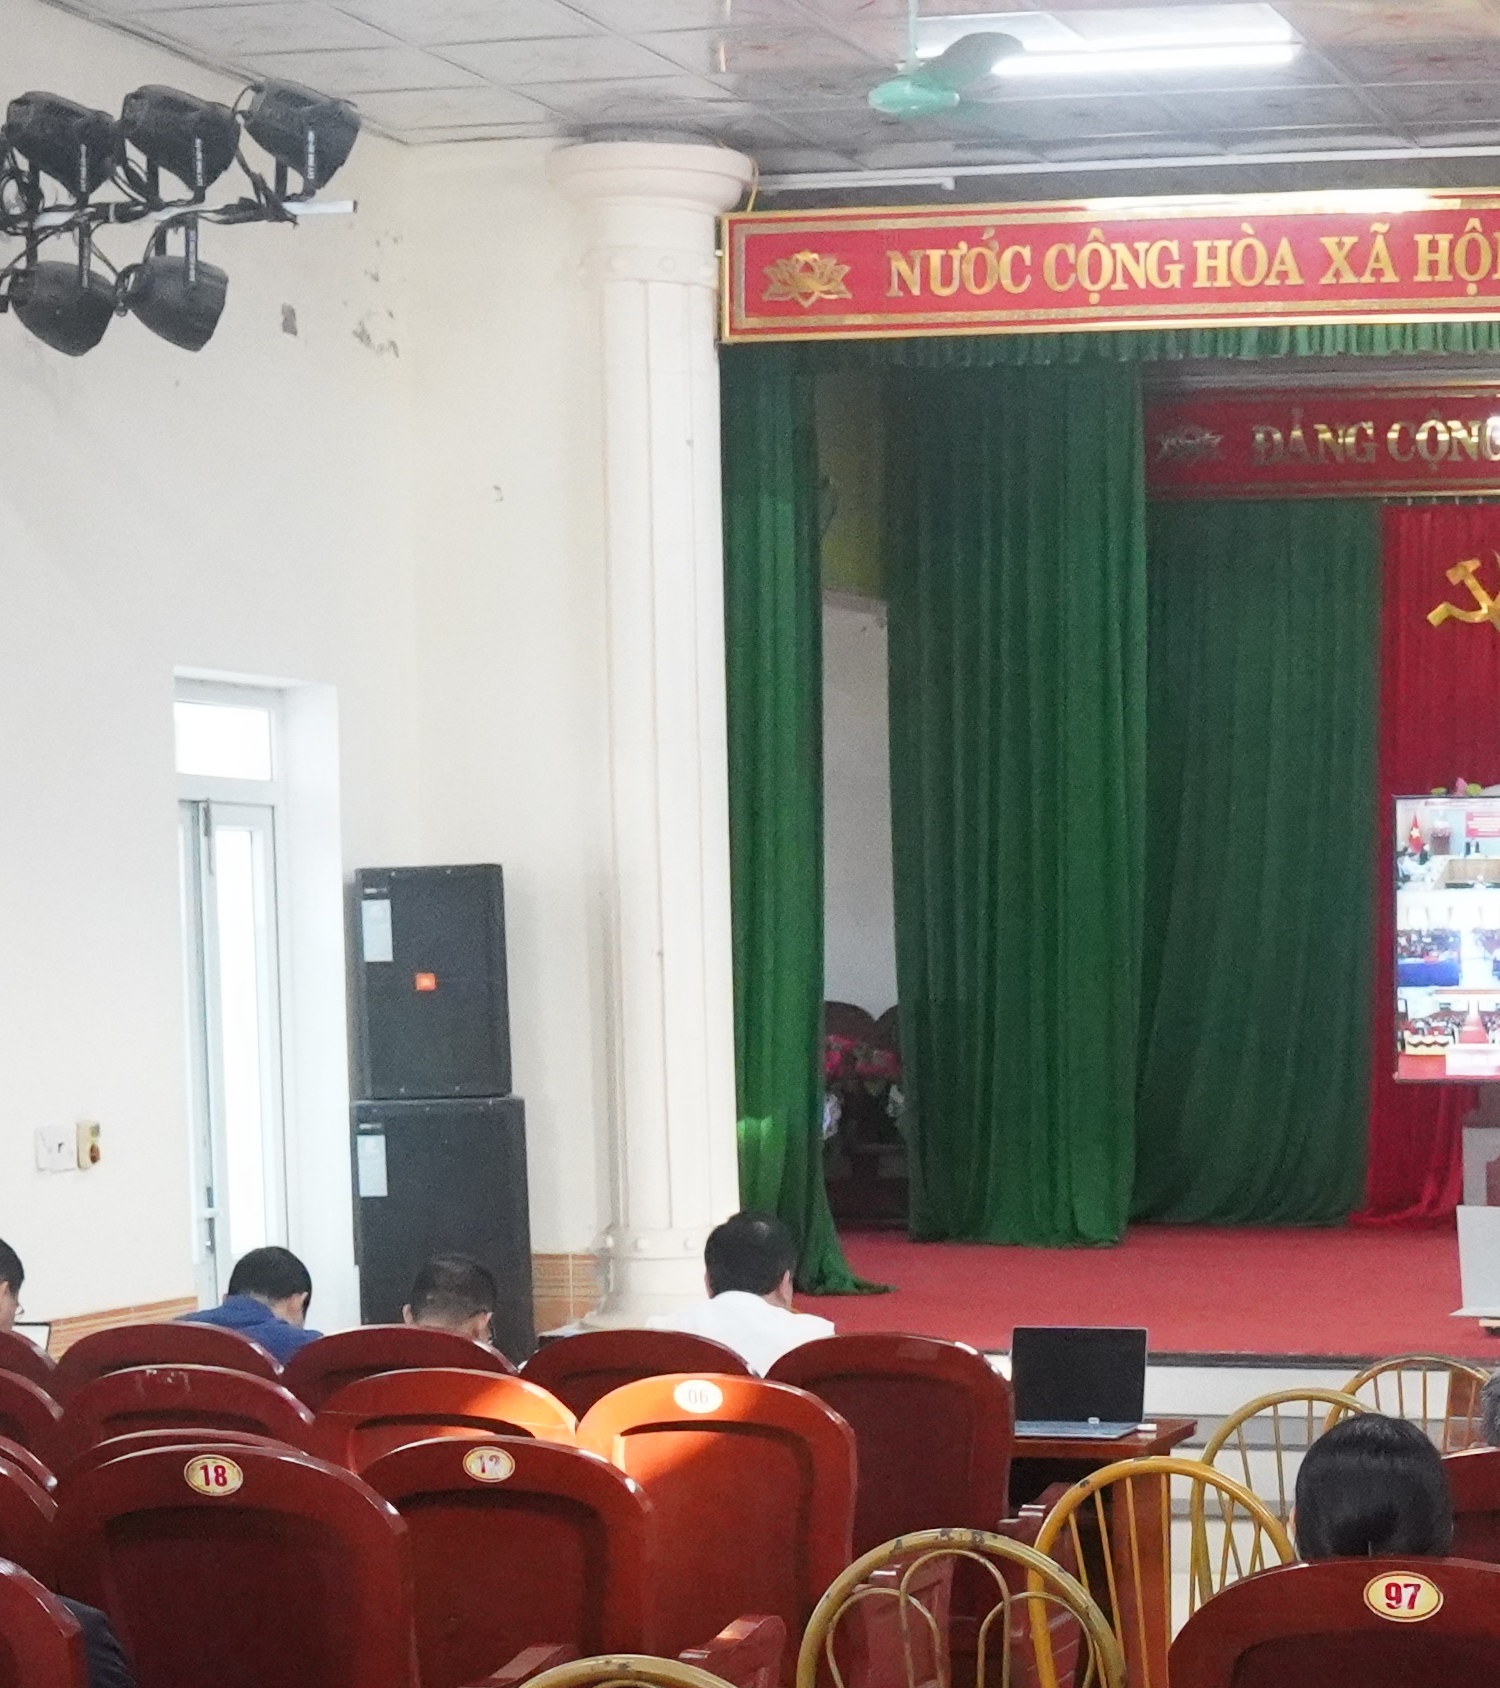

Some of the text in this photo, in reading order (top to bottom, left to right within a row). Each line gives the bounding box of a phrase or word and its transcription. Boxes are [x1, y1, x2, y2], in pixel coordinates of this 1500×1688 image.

[886, 228, 1032, 298] NƯỚC
[1044, 227, 1182, 306] CỘNG
[1194, 222, 1304, 288] HÒA
[1319, 221, 1398, 286] XÃ
[1251, 408, 1375, 466] ĐẢNG
[687, 1387, 709, 1405] 06
[198, 1461, 229, 1489] 18
[1384, 1581, 1423, 1610] 97
